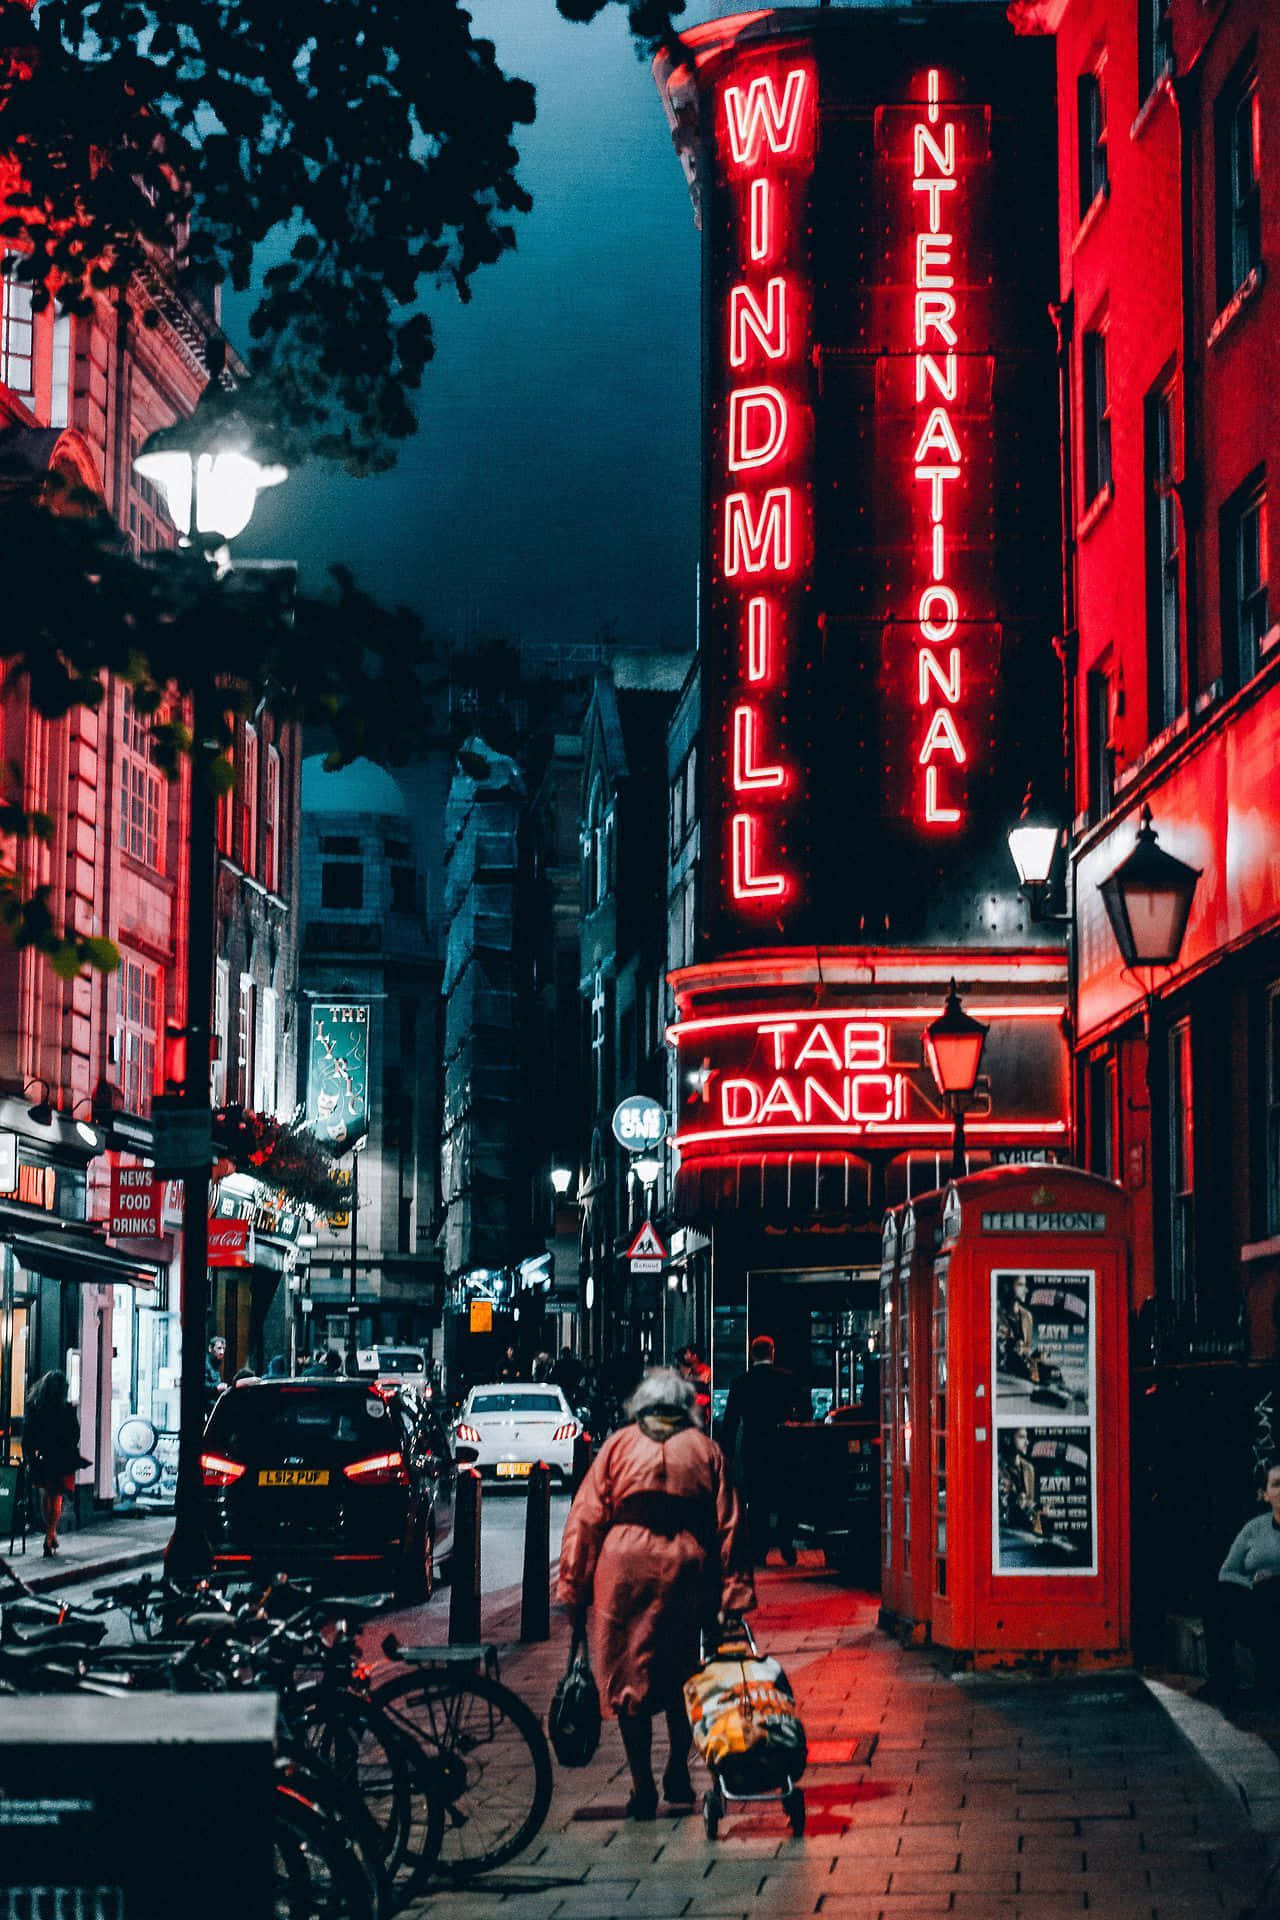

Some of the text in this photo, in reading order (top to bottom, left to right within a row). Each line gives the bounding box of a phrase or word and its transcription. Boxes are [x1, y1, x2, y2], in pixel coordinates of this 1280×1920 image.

[912, 69, 966, 823] INTERNATIONAL
[723, 69, 805, 899] WINDMILL
[329, 1007, 366, 1022] THE
[757, 1022, 928, 1070] TABL
[316, 1020, 364, 1116] LYRIC
[119, 1171, 153, 1187] NEWS
[119, 1194, 151, 1211] FOOD
[112, 1217, 156, 1234] DRINKS
[988, 1213, 1101, 1230] TELEPHONE
[1037, 1324, 1069, 1340] ZAYN
[1039, 1476, 1071, 1492] ZAYN
